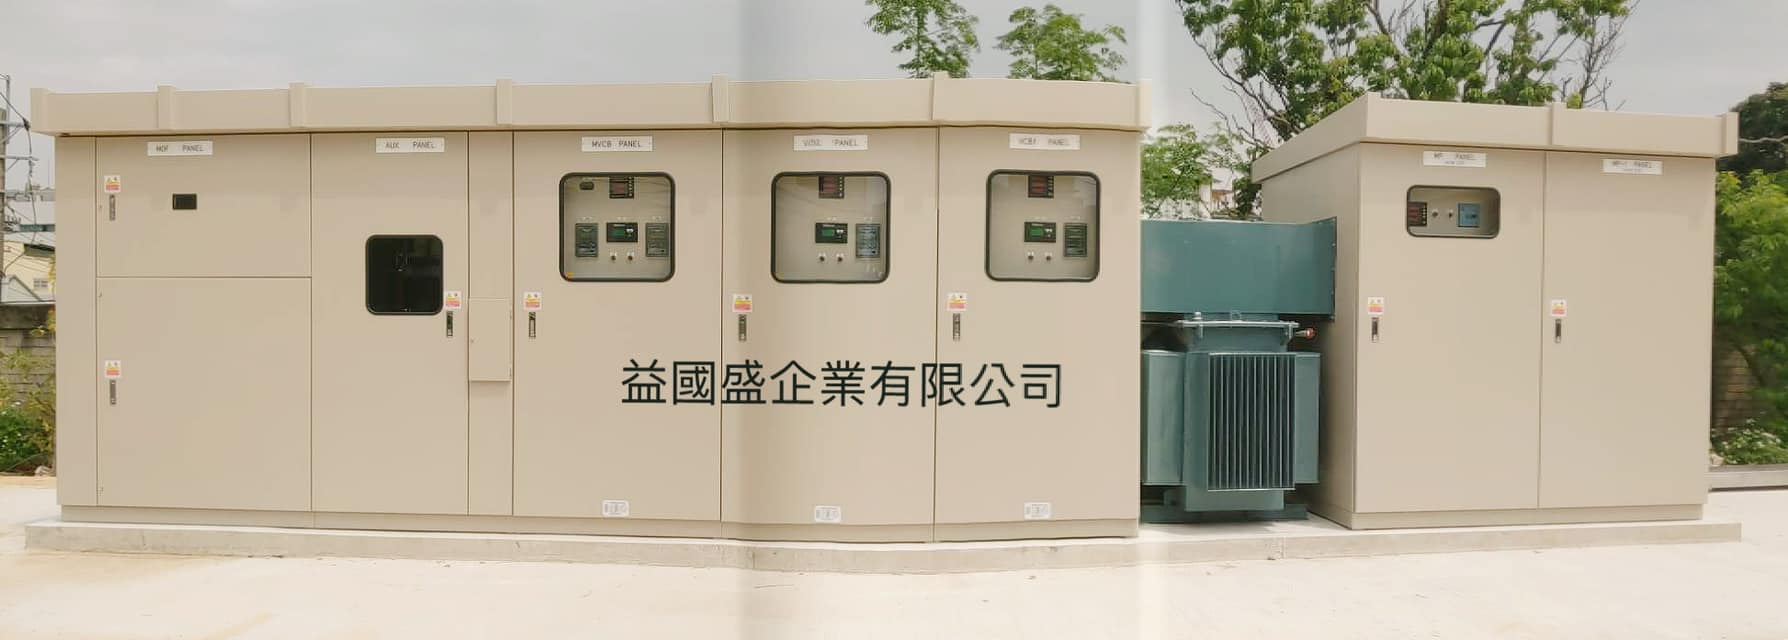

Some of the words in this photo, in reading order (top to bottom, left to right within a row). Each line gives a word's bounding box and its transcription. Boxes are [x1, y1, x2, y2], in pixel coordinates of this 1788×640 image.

[412, 141, 437, 149] PANEL
[618, 140, 642, 148] PANEL
[832, 139, 858, 147] PANEL
[182, 144, 204, 152] PANEL
